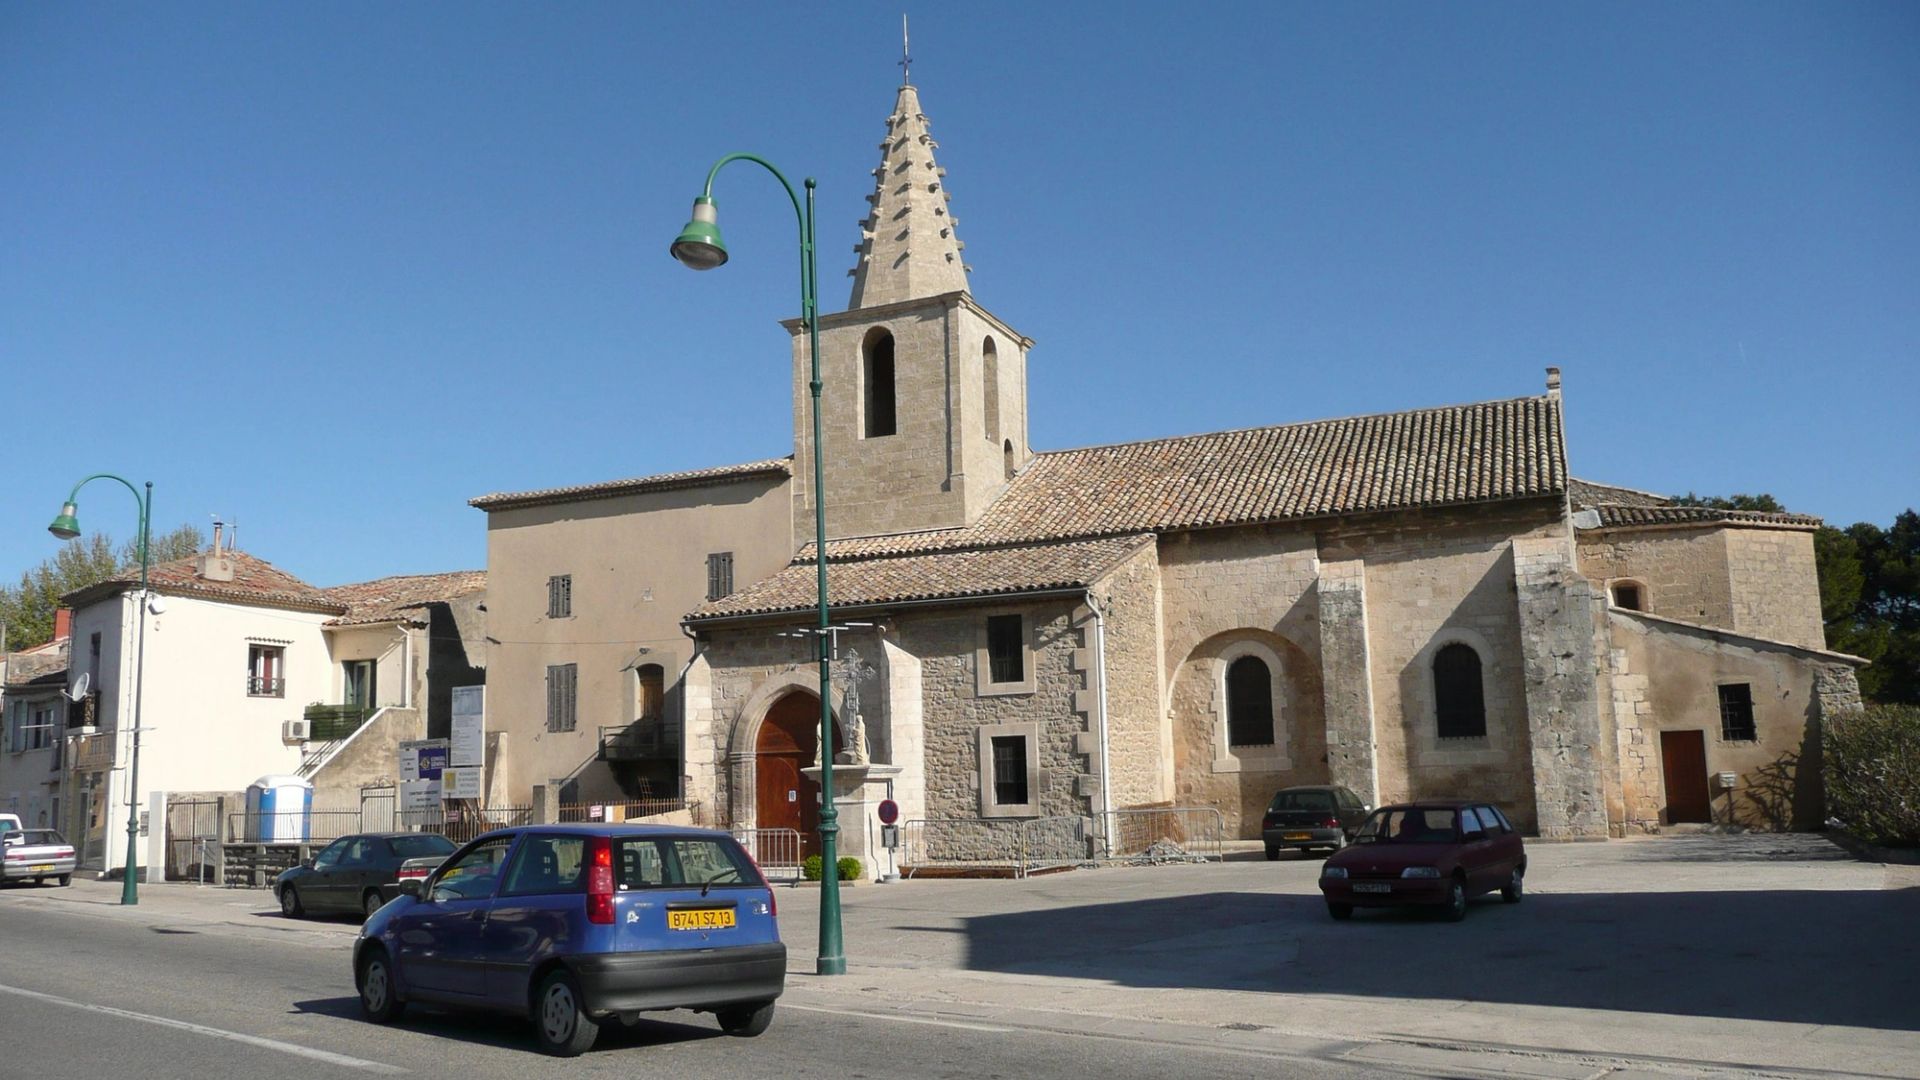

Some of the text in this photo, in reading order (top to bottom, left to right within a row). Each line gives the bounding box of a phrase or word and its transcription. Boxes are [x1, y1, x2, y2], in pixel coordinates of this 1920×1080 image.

[673, 911, 731, 927] 8741 SZ 13
